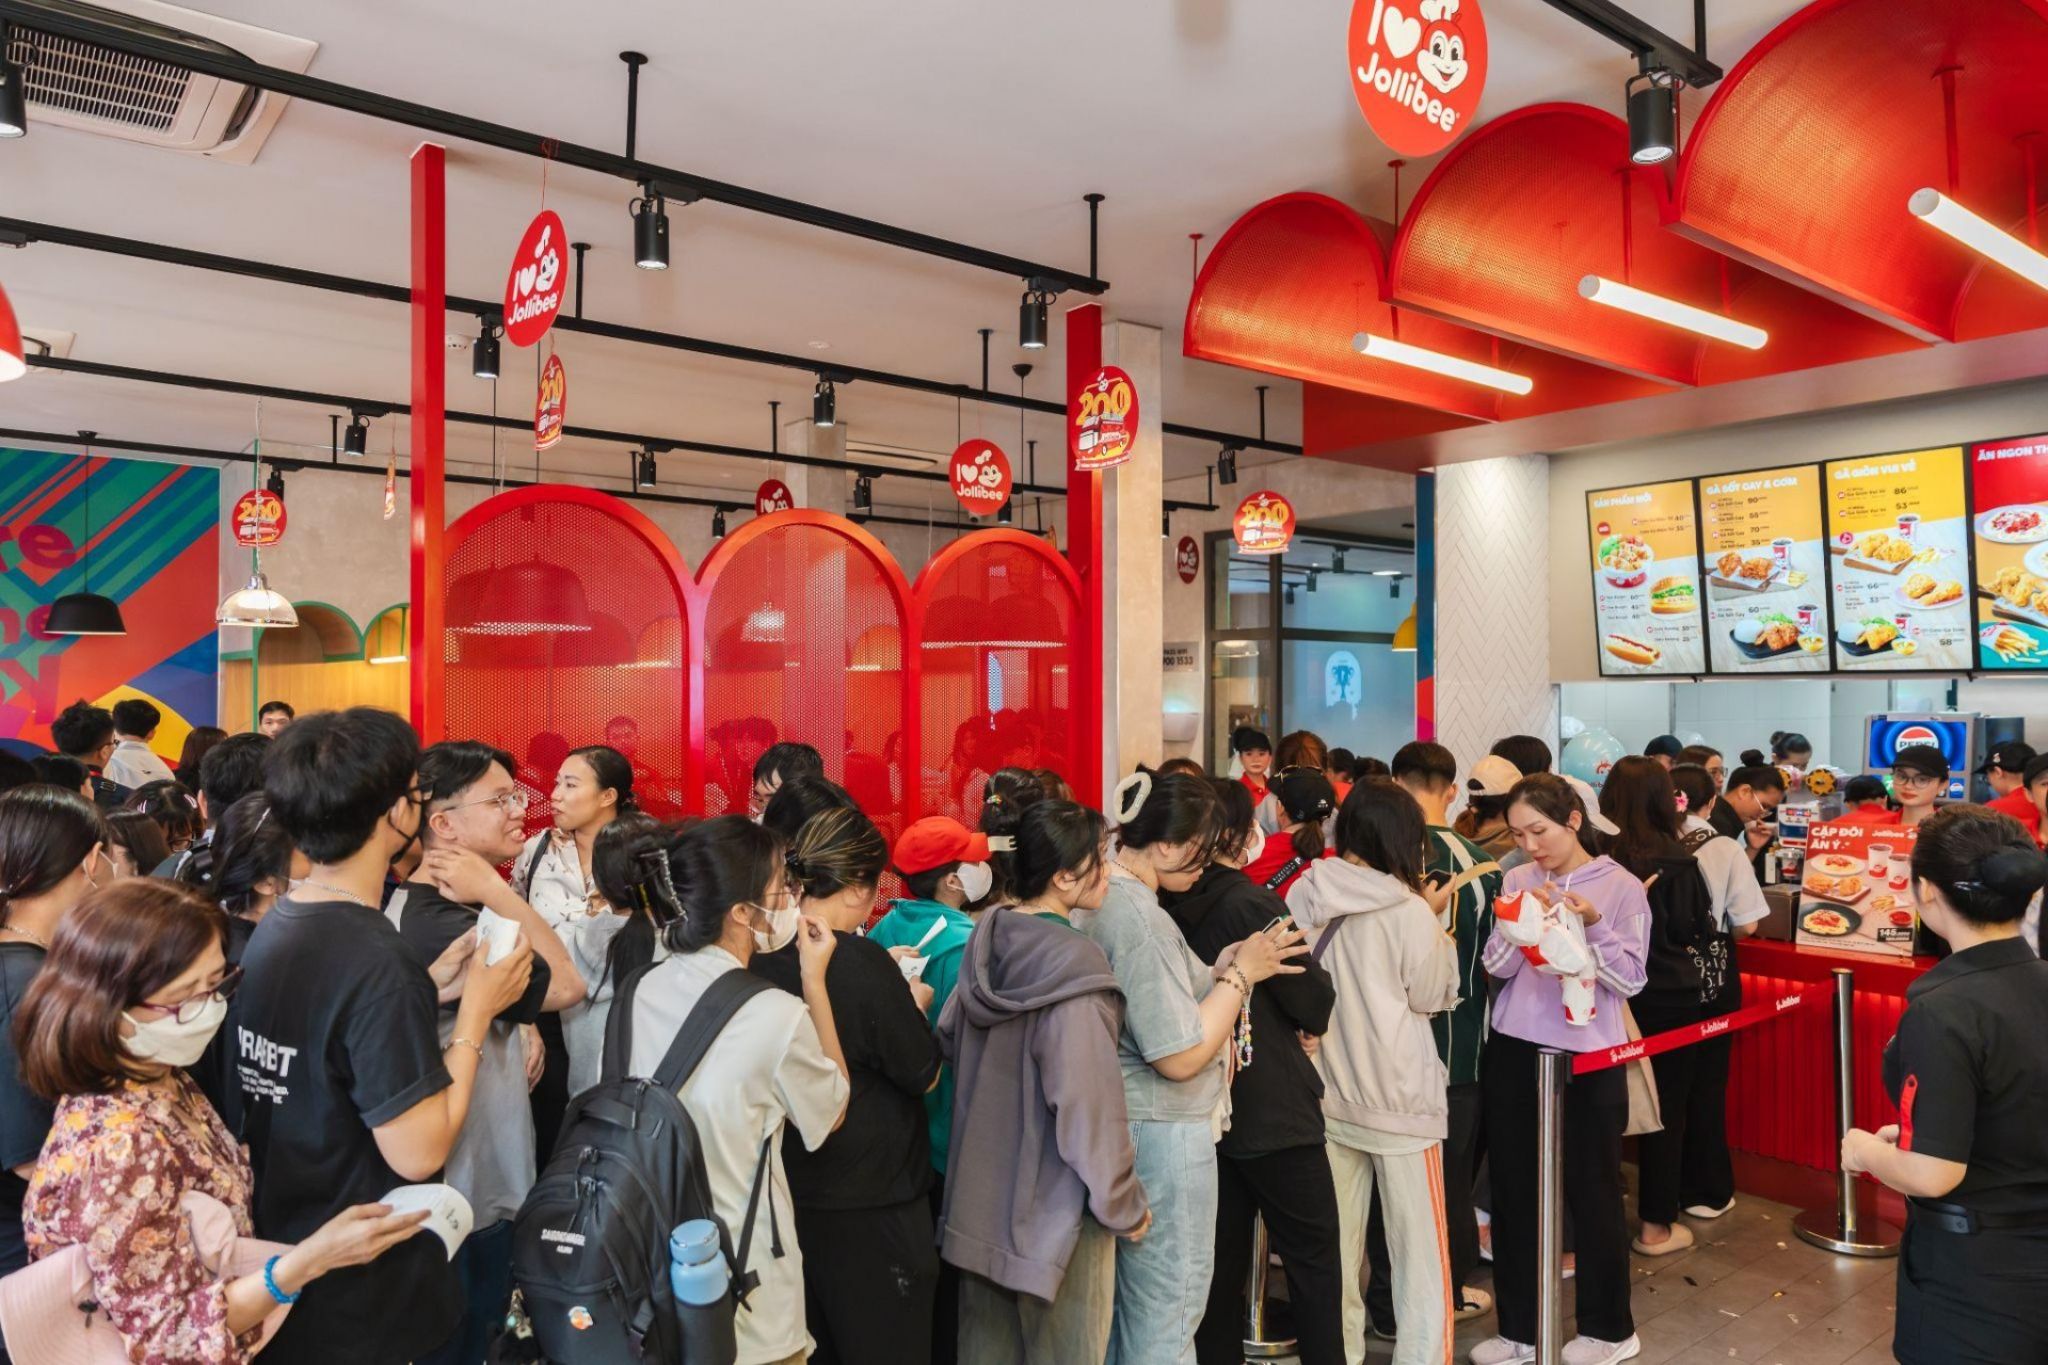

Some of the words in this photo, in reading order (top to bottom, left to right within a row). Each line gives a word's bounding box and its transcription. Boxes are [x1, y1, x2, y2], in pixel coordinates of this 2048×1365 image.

[1366, 0, 1385, 46] I
[1357, 52, 1456, 132] Jollibee
[512, 270, 520, 302] I
[508, 292, 558, 325] Jollibee
[956, 463, 962, 482] I
[956, 483, 1003, 501] Jollibee
[1811, 825, 1837, 839] CẶP
